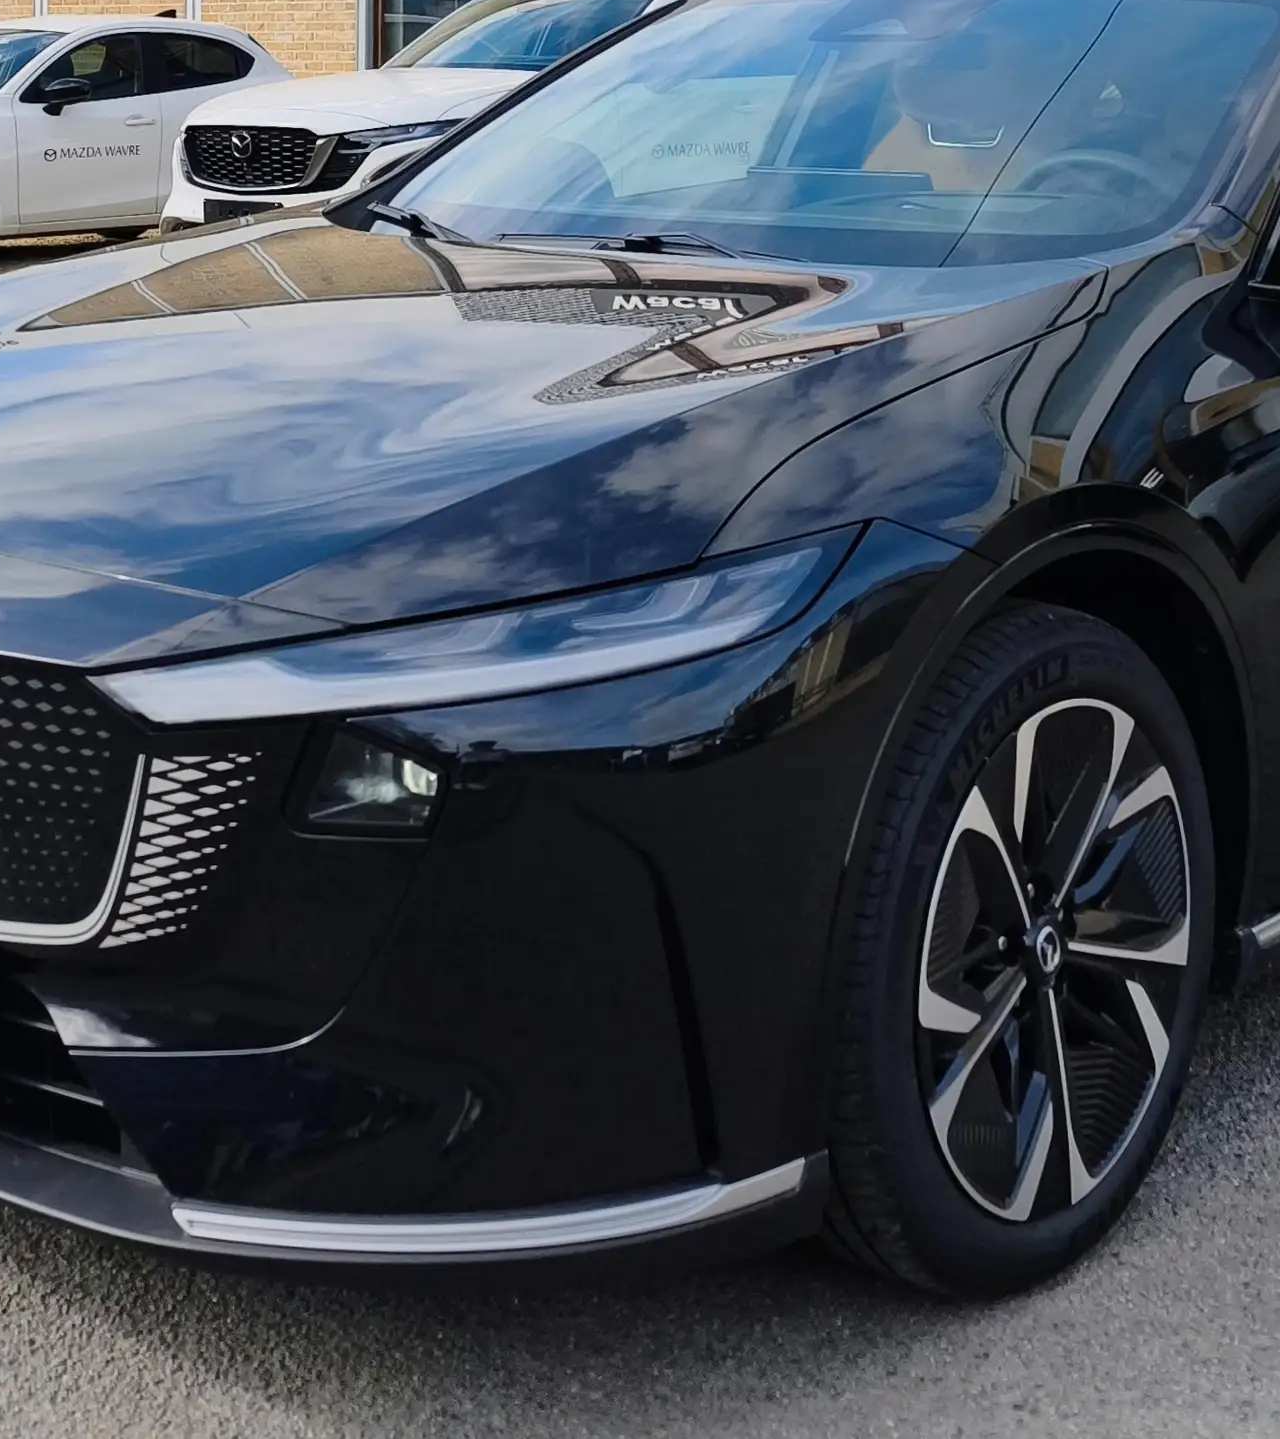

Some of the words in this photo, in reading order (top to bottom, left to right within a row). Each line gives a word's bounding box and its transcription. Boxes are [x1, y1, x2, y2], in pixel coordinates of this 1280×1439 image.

[59, 146, 102, 159] MAZDA
[105, 144, 141, 157] WAVRE
[667, 142, 711, 157] MAZDA
